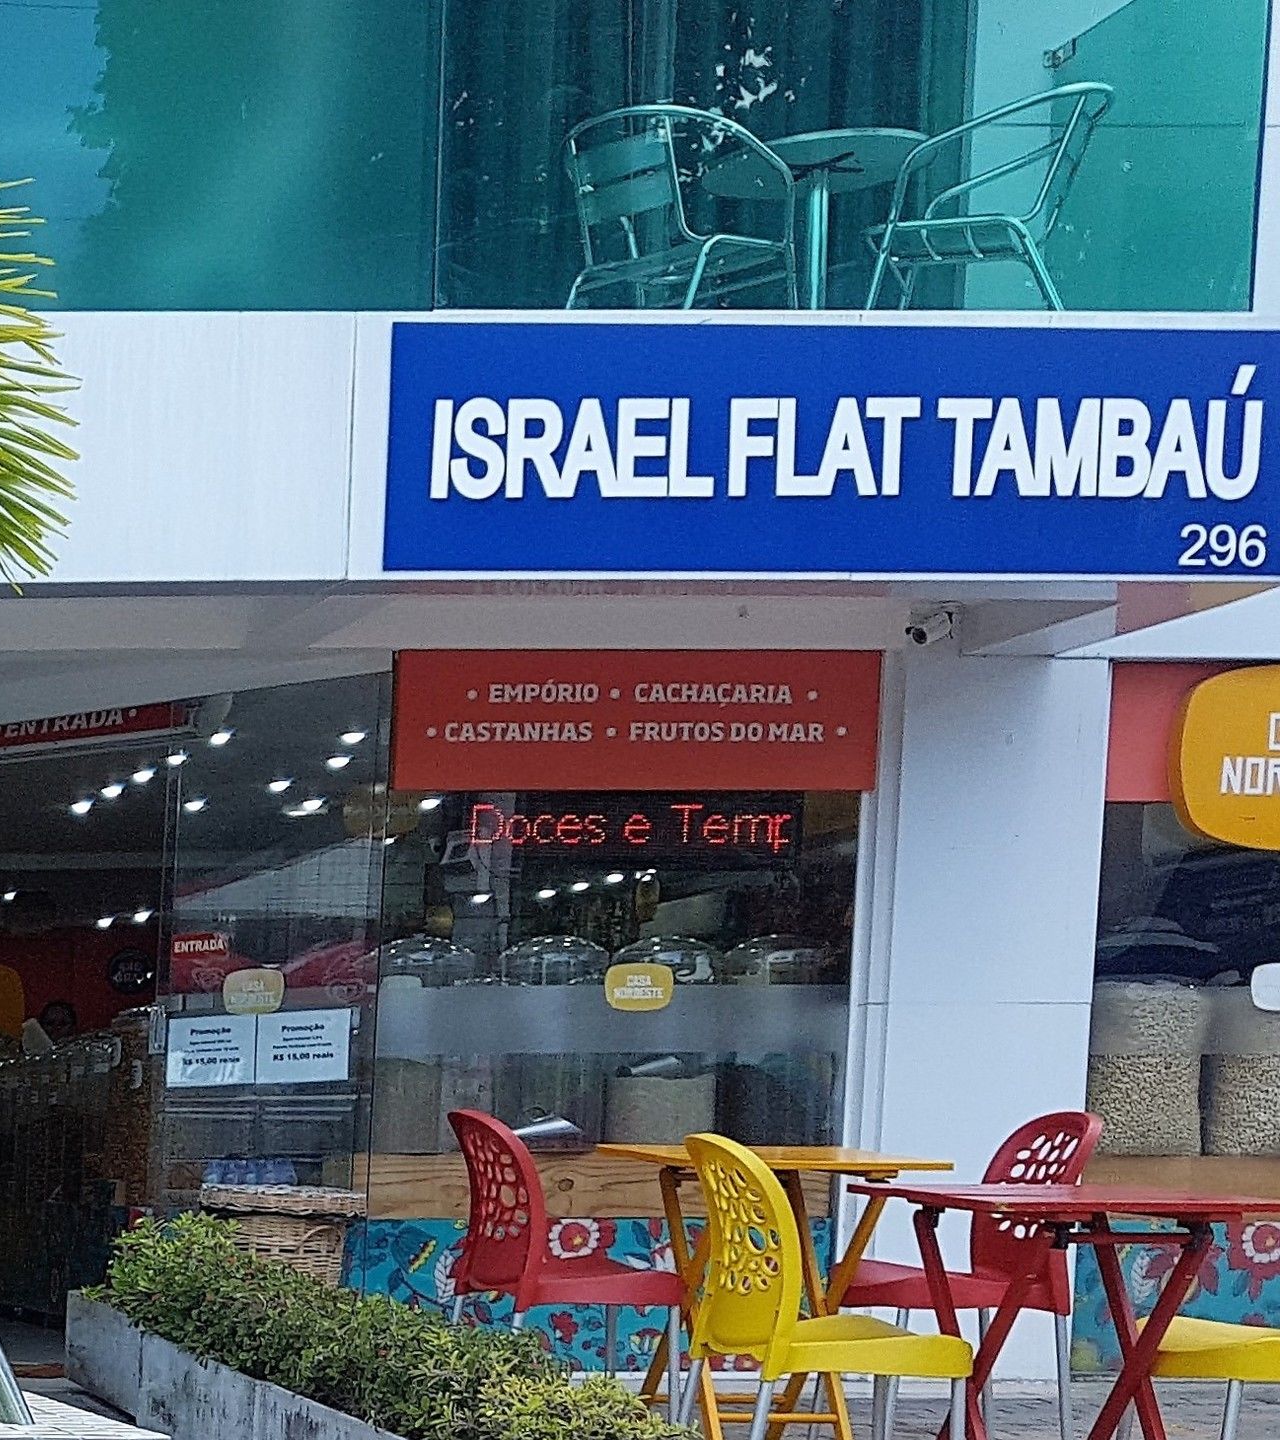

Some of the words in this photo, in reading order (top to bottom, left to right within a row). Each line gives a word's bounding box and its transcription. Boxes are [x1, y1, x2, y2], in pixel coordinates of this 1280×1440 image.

[430, 397, 713, 500] ISRAEL
[728, 397, 921, 499] FLAT
[937, 364, 1264, 501] TAMBAÚ
[1179, 524, 1268, 569] 296
[488, 679, 600, 704] EMPÓRIO
[634, 683, 793, 709] CACHAÇARIA
[4, 708, 125, 738] ENTRADA
[444, 721, 592, 743] CASTANHAS
[629, 721, 724, 742] FRUTOS
[730, 722, 764, 742] DO
[768, 722, 826, 742] MAR
[470, 803, 607, 845] Doces
[624, 814, 652, 844] e
[173, 939, 224, 954] ENTRADA
